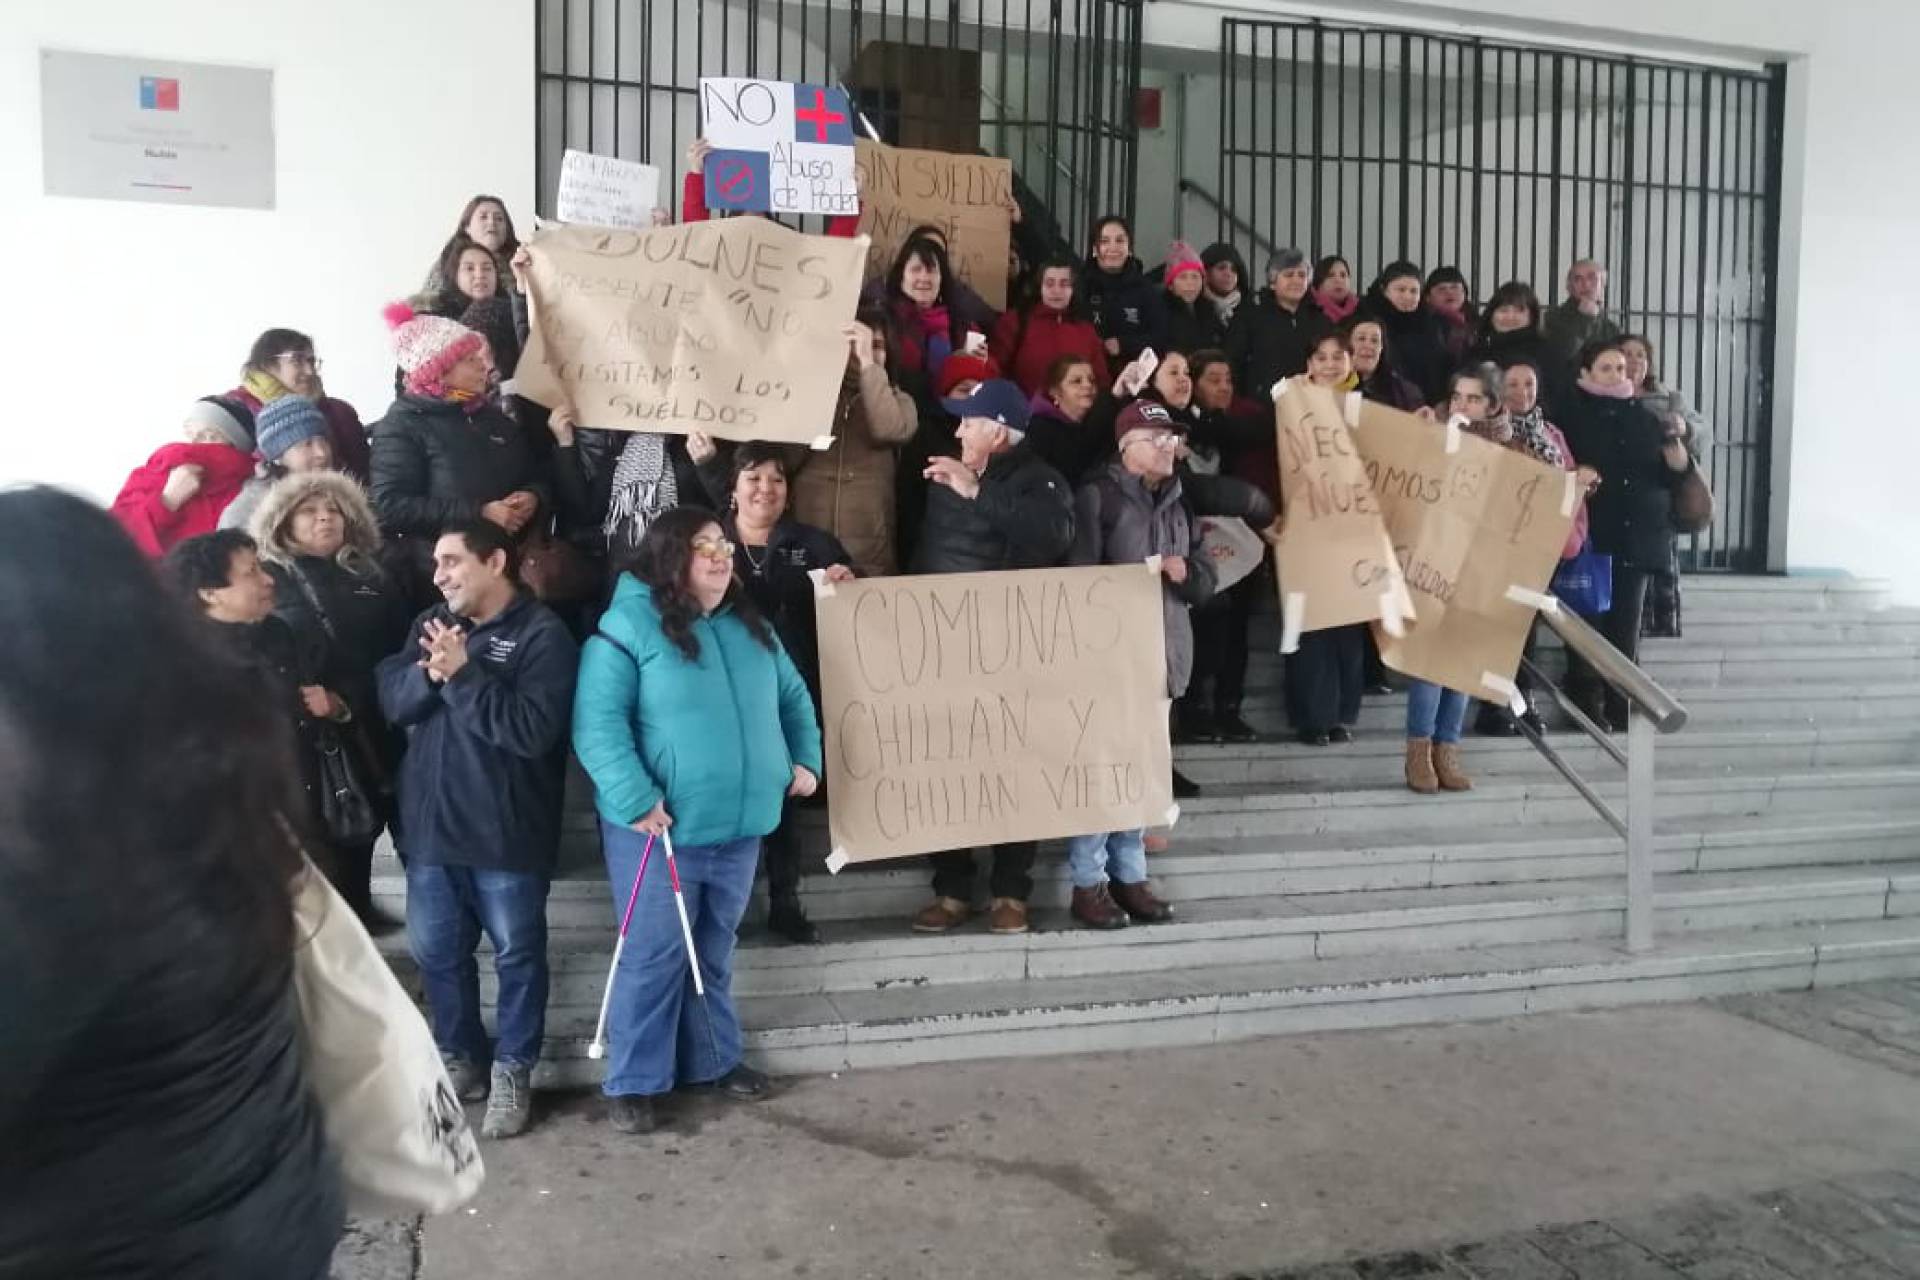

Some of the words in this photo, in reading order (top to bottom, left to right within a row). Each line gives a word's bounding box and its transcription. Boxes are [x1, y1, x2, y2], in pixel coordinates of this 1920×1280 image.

[704, 83, 776, 126] NO
[770, 141, 834, 180] Abuso
[774, 176, 798, 209] de
[607, 394, 759, 425] SUELDOS
[854, 575, 1122, 694] COMUNAS
[840, 689, 1031, 781] CHILLAN
[1068, 698, 1095, 759] Y
[873, 771, 1020, 842] CHILLAN
[1041, 761, 1146, 811] VIEJO
